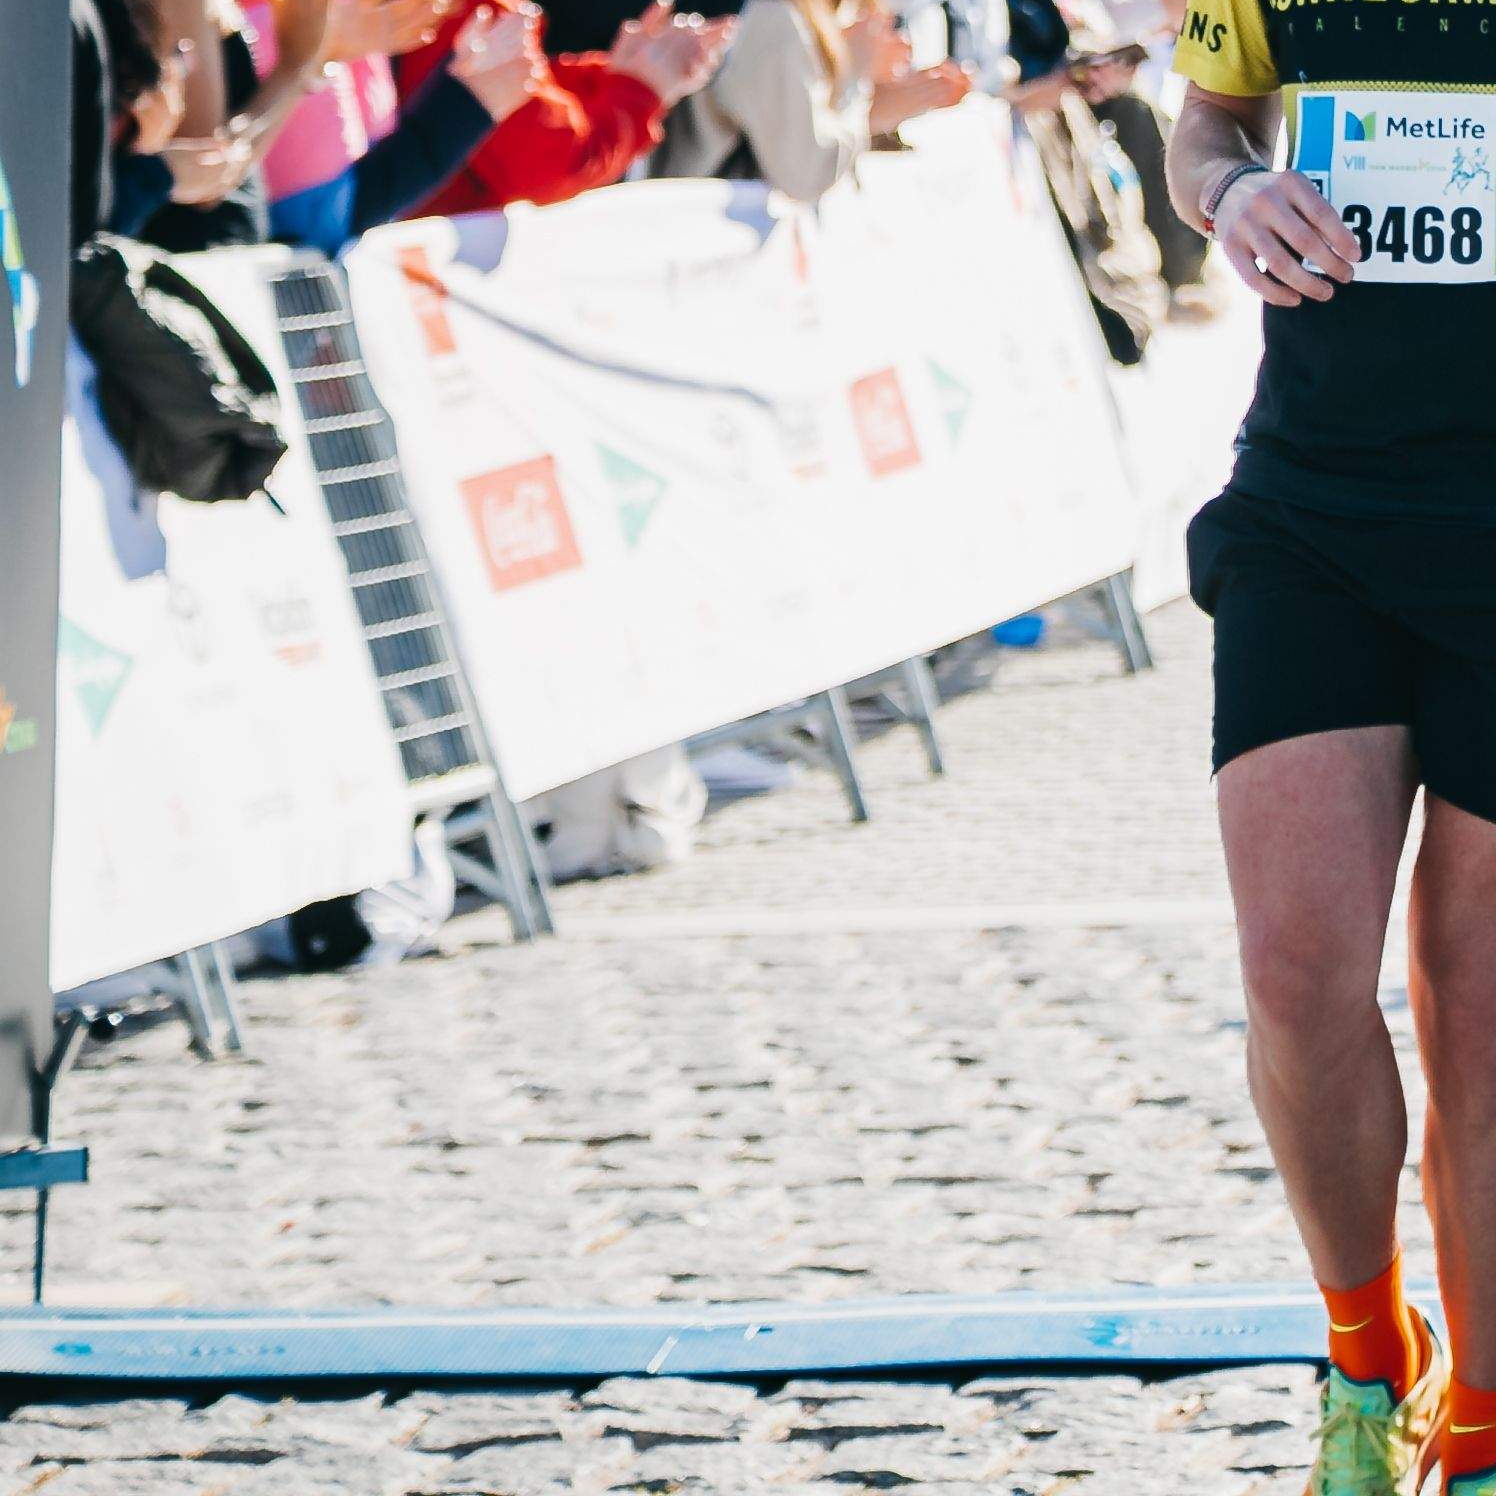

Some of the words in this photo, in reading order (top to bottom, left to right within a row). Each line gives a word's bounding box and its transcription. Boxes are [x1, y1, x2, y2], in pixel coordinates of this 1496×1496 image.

[1180, 11, 1227, 53] NS
[1386, 117, 1485, 139] MetLife
[1342, 204, 1483, 265] 3468
